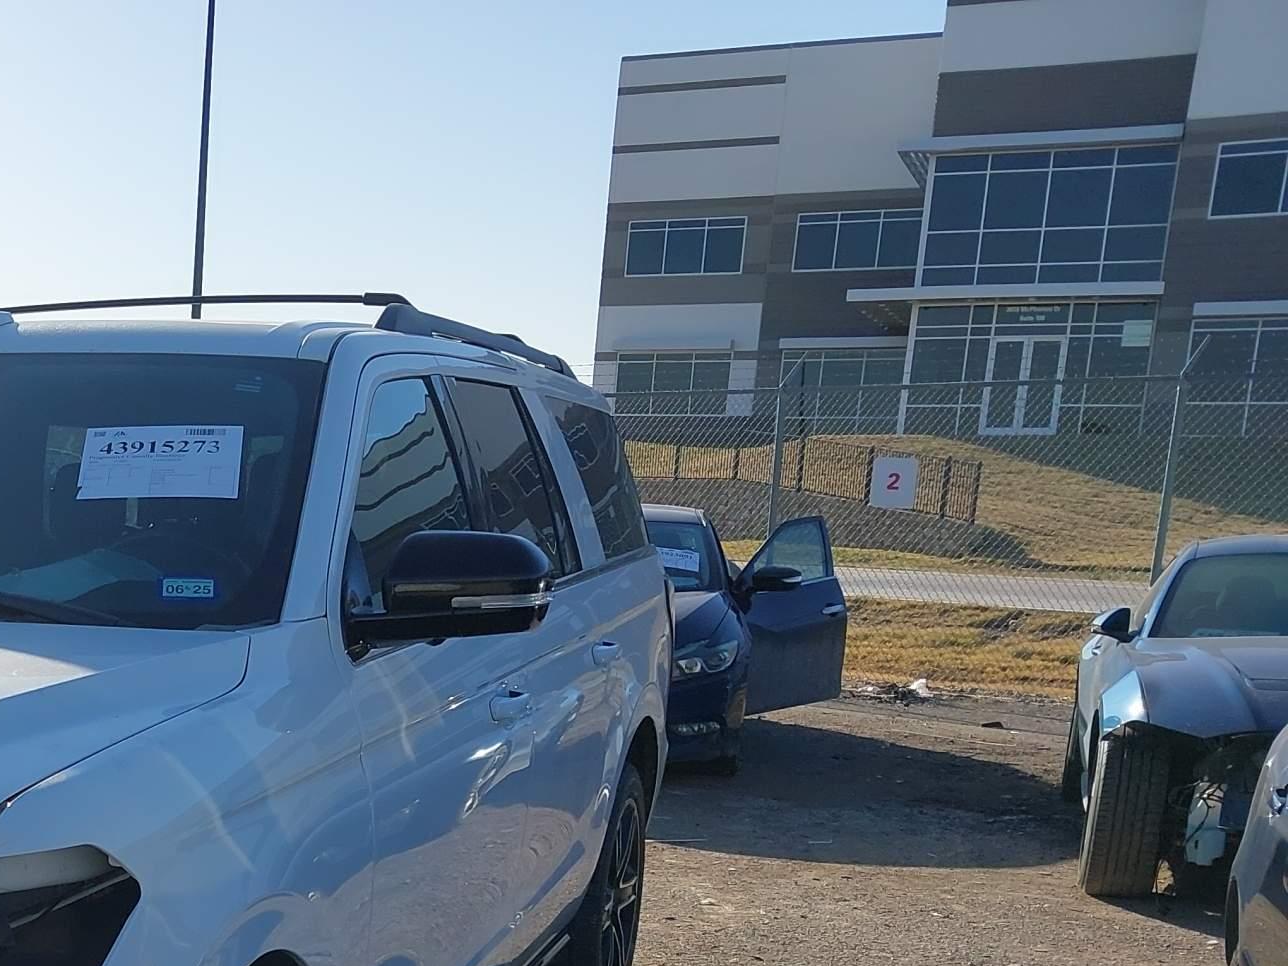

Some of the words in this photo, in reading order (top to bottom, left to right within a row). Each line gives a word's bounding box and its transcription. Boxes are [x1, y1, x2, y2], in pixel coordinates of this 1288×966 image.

[99, 440, 221, 455] 43915273
[886, 472, 901, 490] 2
[166, 584, 184, 594] 06
[192, 585, 211, 595] 25
